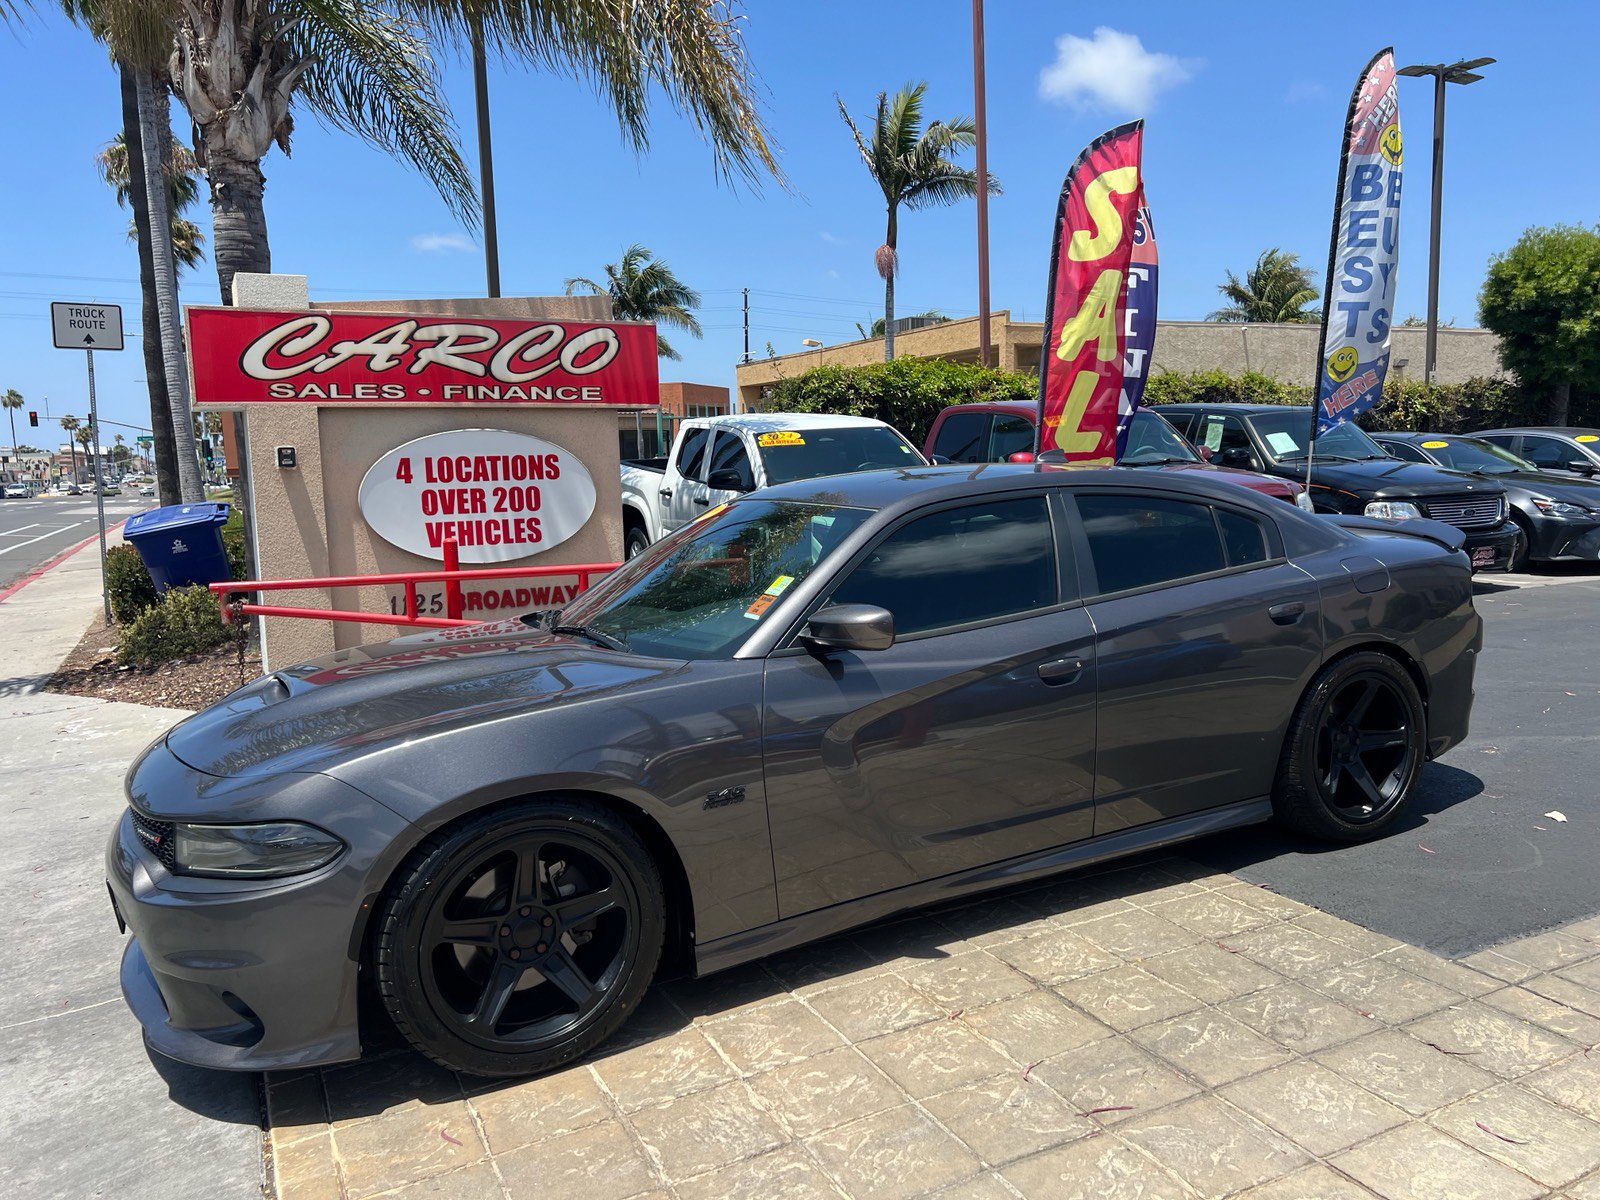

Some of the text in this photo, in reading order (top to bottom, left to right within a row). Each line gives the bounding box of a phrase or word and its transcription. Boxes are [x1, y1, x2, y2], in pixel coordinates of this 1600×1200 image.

[1338, 164, 1383, 337] BEST
[1366, 171, 1402, 344] BUYS
[68, 307, 106, 319] TRUCK
[69, 319, 106, 330] ROUTE
[1057, 166, 1137, 464] SAL
[239, 315, 621, 383] CARCO
[268, 383, 602, 401] SALES FINANCE
[1322, 368, 1379, 419] HERE
[396, 454, 560, 484] 4 LOCATIONS
[421, 486, 541, 515] OVER 200
[425, 517, 542, 548] VEHICLES
